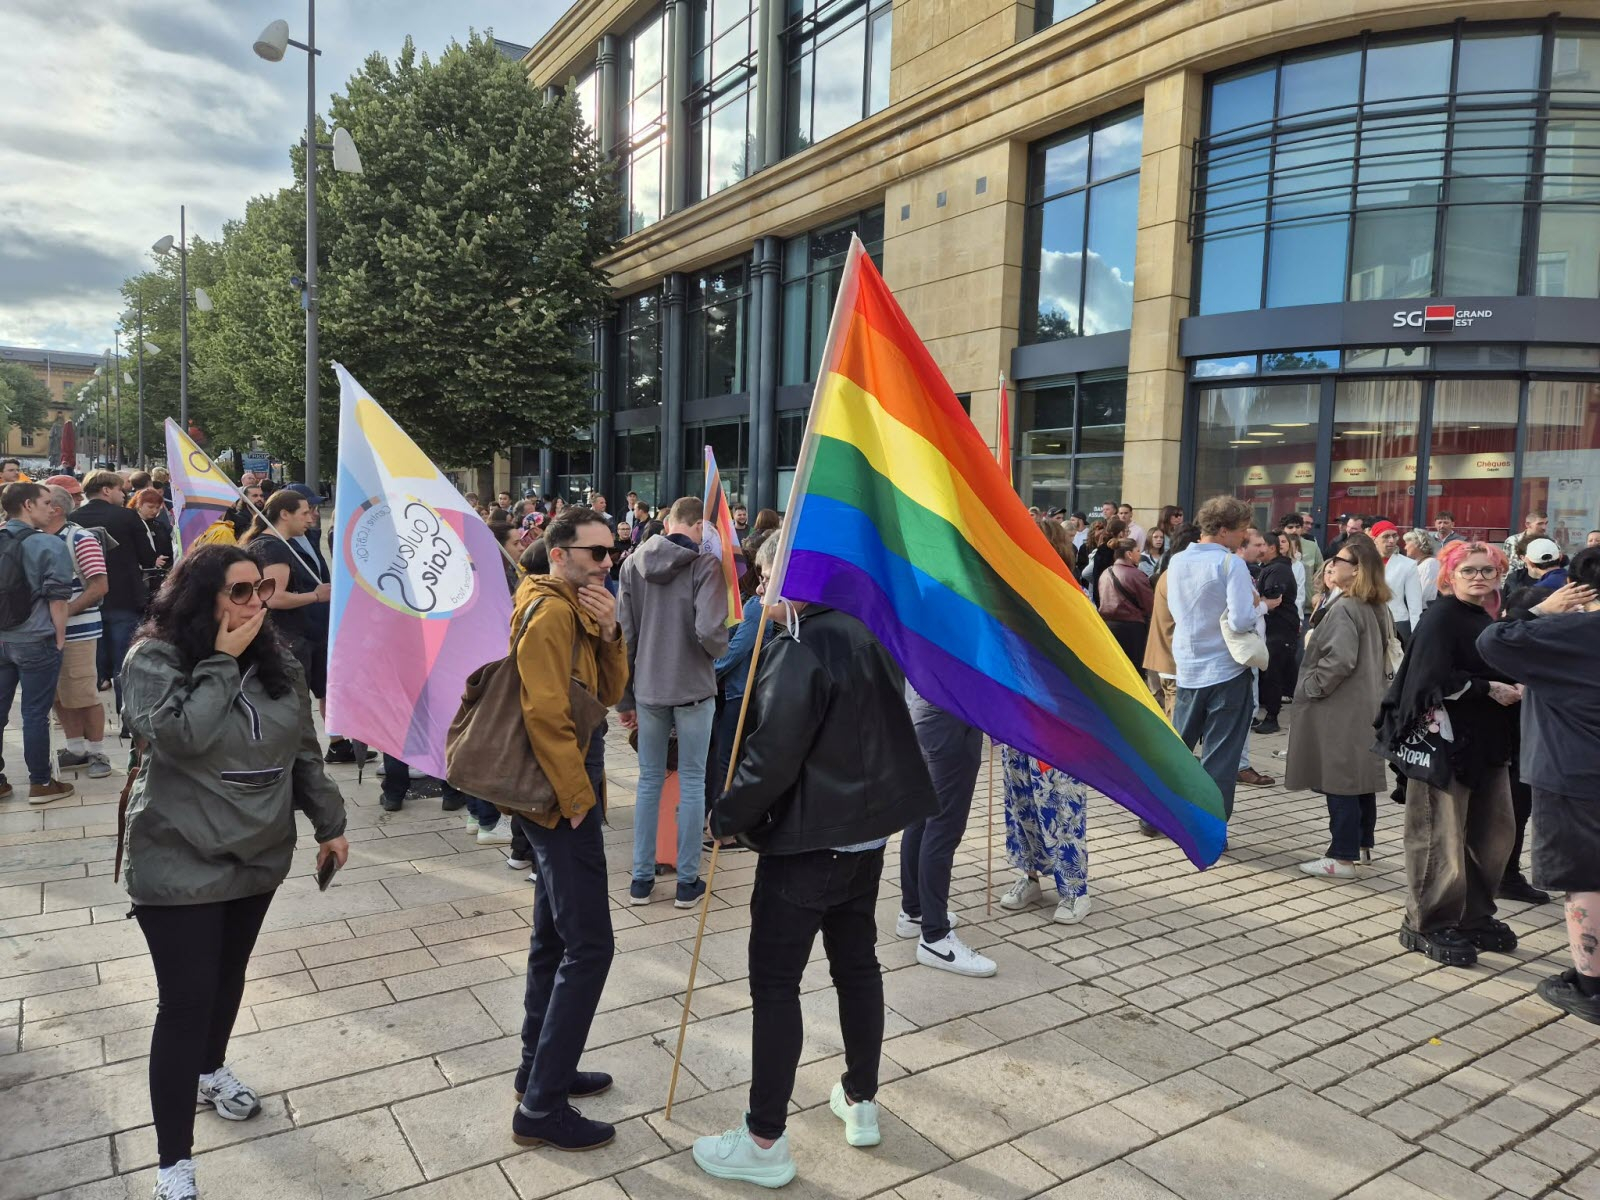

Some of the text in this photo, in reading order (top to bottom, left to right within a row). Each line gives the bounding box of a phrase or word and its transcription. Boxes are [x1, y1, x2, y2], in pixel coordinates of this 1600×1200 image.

[1393, 311, 1422, 327] SG
[1456, 310, 1492, 318] GRAND
[1455, 319, 1474, 327] EST
[1396, 744, 1431, 768] STOPIA
